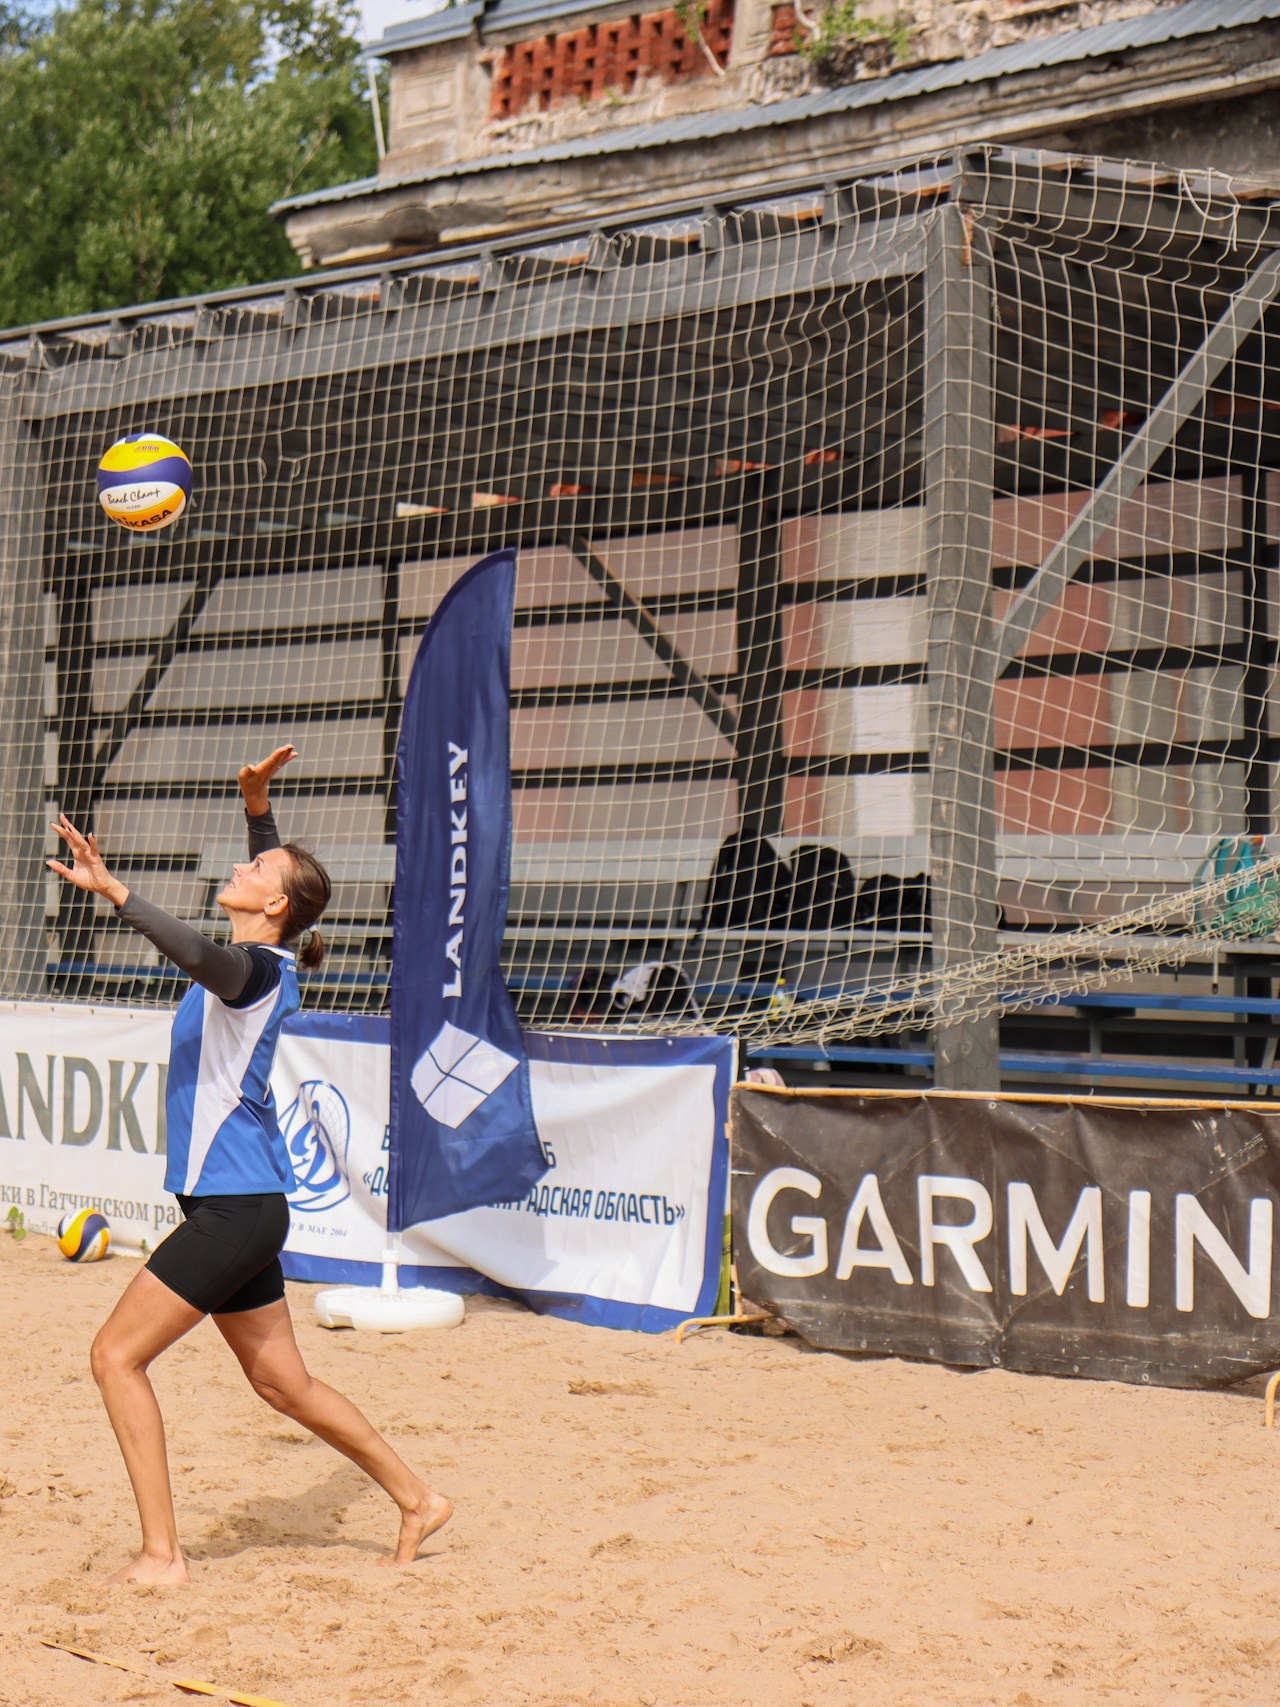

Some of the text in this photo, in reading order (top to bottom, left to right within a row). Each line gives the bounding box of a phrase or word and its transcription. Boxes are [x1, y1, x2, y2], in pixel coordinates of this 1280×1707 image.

[107, 488, 160, 504] Beach Champ
[442, 740, 469, 999] LANDKEY
[25, 1188, 36, 1207] в
[39, 1184, 151, 1222] Гатчинском
[594, 1190, 686, 1226] ОБЛАСТЬ»
[747, 1166, 1274, 1320] GARMIN
